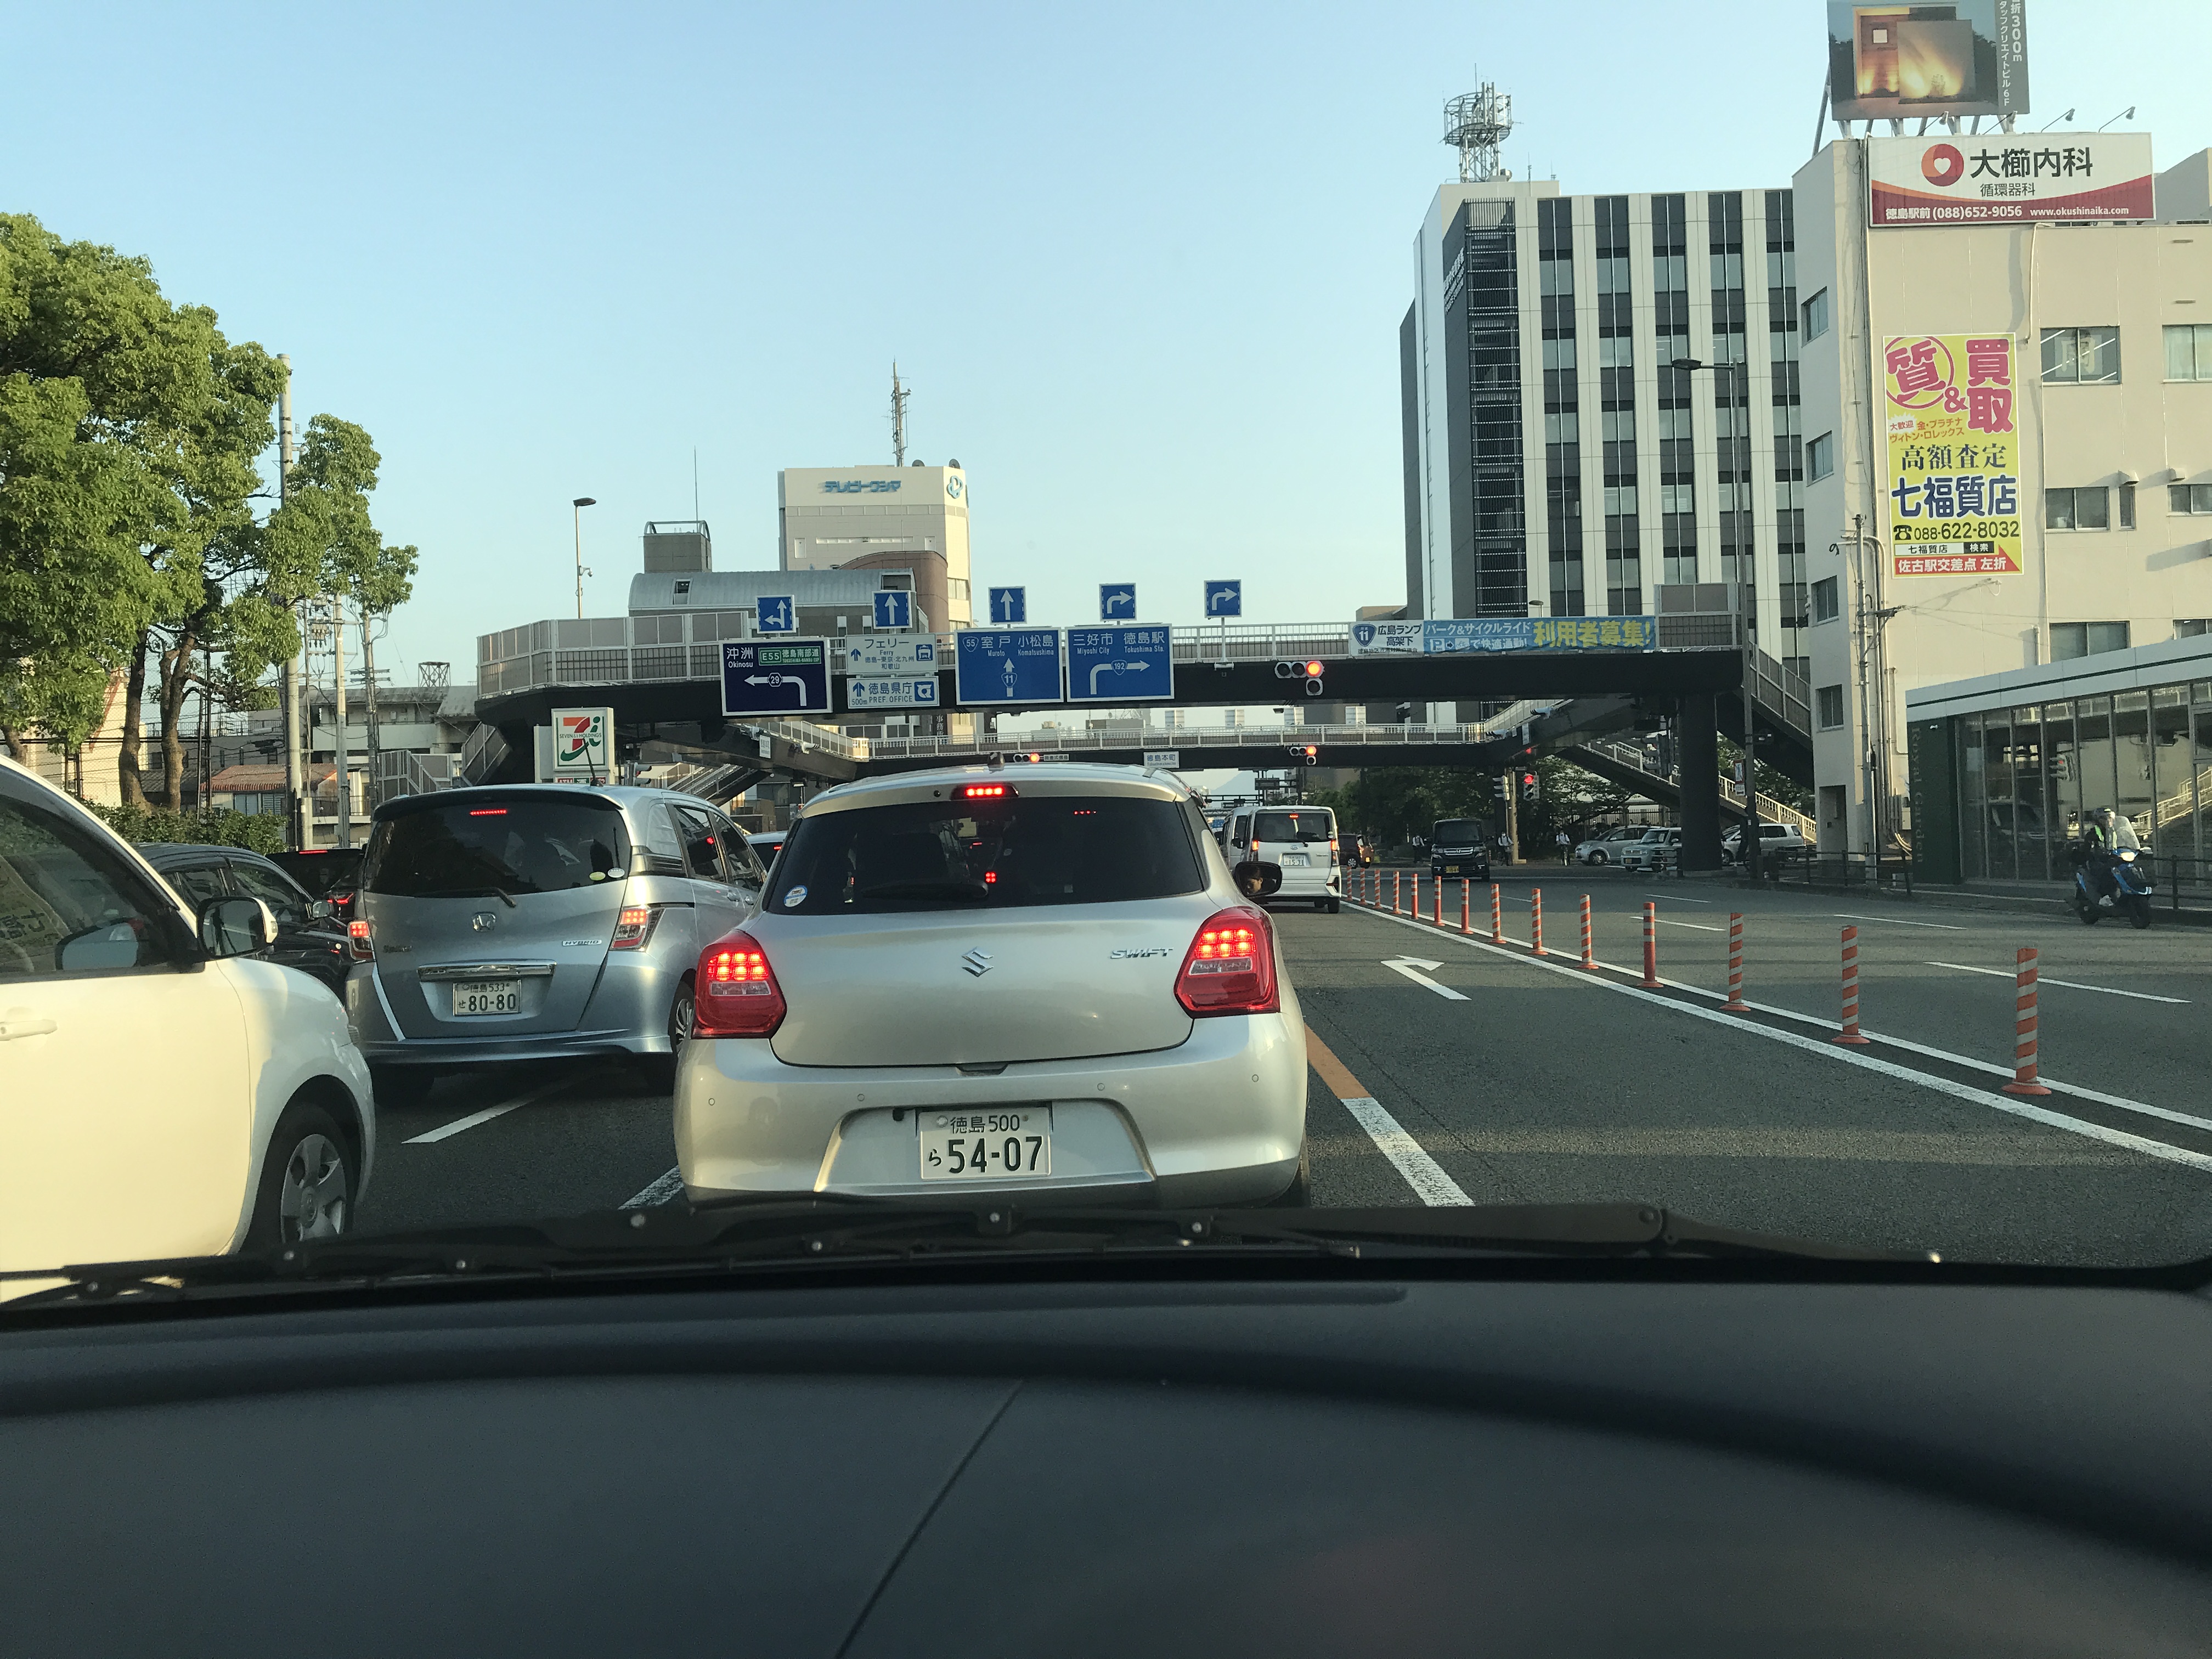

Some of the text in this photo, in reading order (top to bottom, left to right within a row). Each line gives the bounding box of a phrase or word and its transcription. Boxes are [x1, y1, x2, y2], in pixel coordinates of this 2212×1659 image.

[1970, 146, 2093, 178] 大櫛内科
[1979, 183, 2036, 197] 循環器科
[1886, 205, 2129, 220] 徳島駅前 (088)652-9056 www.okushinaika.com
[1886, 340, 1946, 404] 質
[1944, 387, 1968, 413] &
[1966, 338, 2014, 434] 買取
[1889, 420, 1914, 431] 大歓迎
[1900, 443, 2007, 471] 高額査定
[825, 480, 901, 493] テレビトクシマ
[1892, 475, 2017, 518] 七福質店
[1914, 521, 2020, 540] 088-622-8032
[1908, 543, 1989, 554] 七福質店 検索
[1898, 557, 2006, 573] 佐古駅交差点 左折
[1378, 624, 1423, 635] 広島ランプ
[1425, 622, 1531, 635] パーク&サイクルライド
[981, 636, 1011, 649] 室戸
[1018, 634, 1053, 648] 小松島
[1073, 633, 1113, 646] 三好市
[1124, 631, 1165, 645] 徳島駅
[1359, 631, 1369, 641] 11
[1386, 636, 1413, 646] 高架下
[865, 638, 910, 649] フェリー
[966, 639, 975, 647] 55
[726, 647, 753, 660] 沖洲
[762, 652, 780, 661] E55
[782, 648, 819, 658] 徳島南部道
[1077, 647, 1110, 656] Miyoshi City
[770, 675, 780, 684] 29
[1005, 675, 1013, 684] 11
[868, 682, 912, 695] 徳島県庁
[1110, 947, 1174, 959] SWIFT
[470, 983, 505, 994] 徳島 533
[458, 993, 517, 1012] せ 80-80
[950, 1114, 1020, 1135] 徳島 500
[928, 1136, 1043, 1174] ら 54-07
